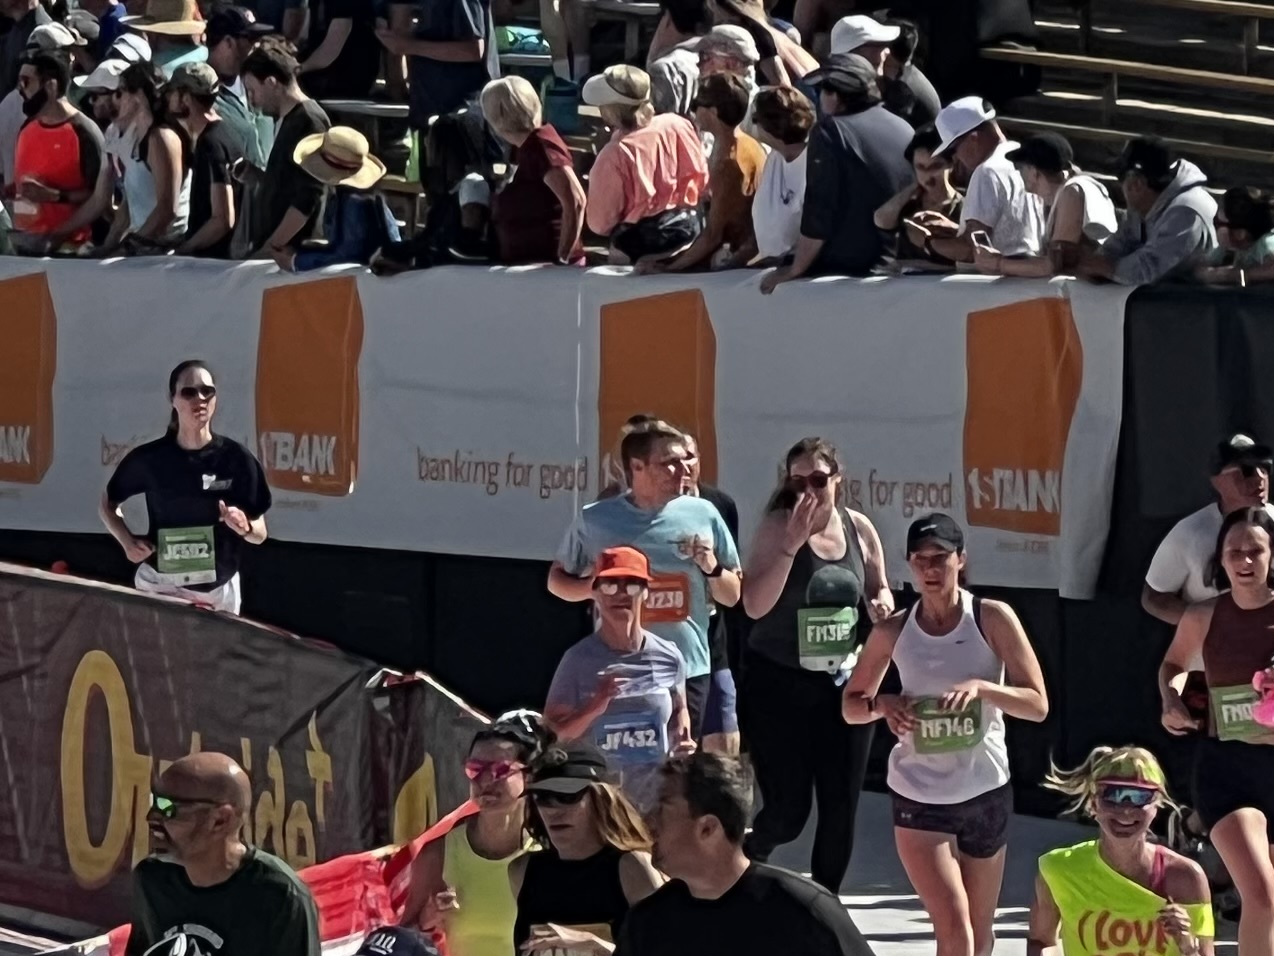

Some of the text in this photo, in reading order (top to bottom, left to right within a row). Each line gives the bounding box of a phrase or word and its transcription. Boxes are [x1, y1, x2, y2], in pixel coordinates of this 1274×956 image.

[417, 446, 500, 496] banking
[505, 452, 534, 488] for
[539, 455, 588, 499] good
[869, 468, 898, 511] for
[903, 471, 952, 518] good
